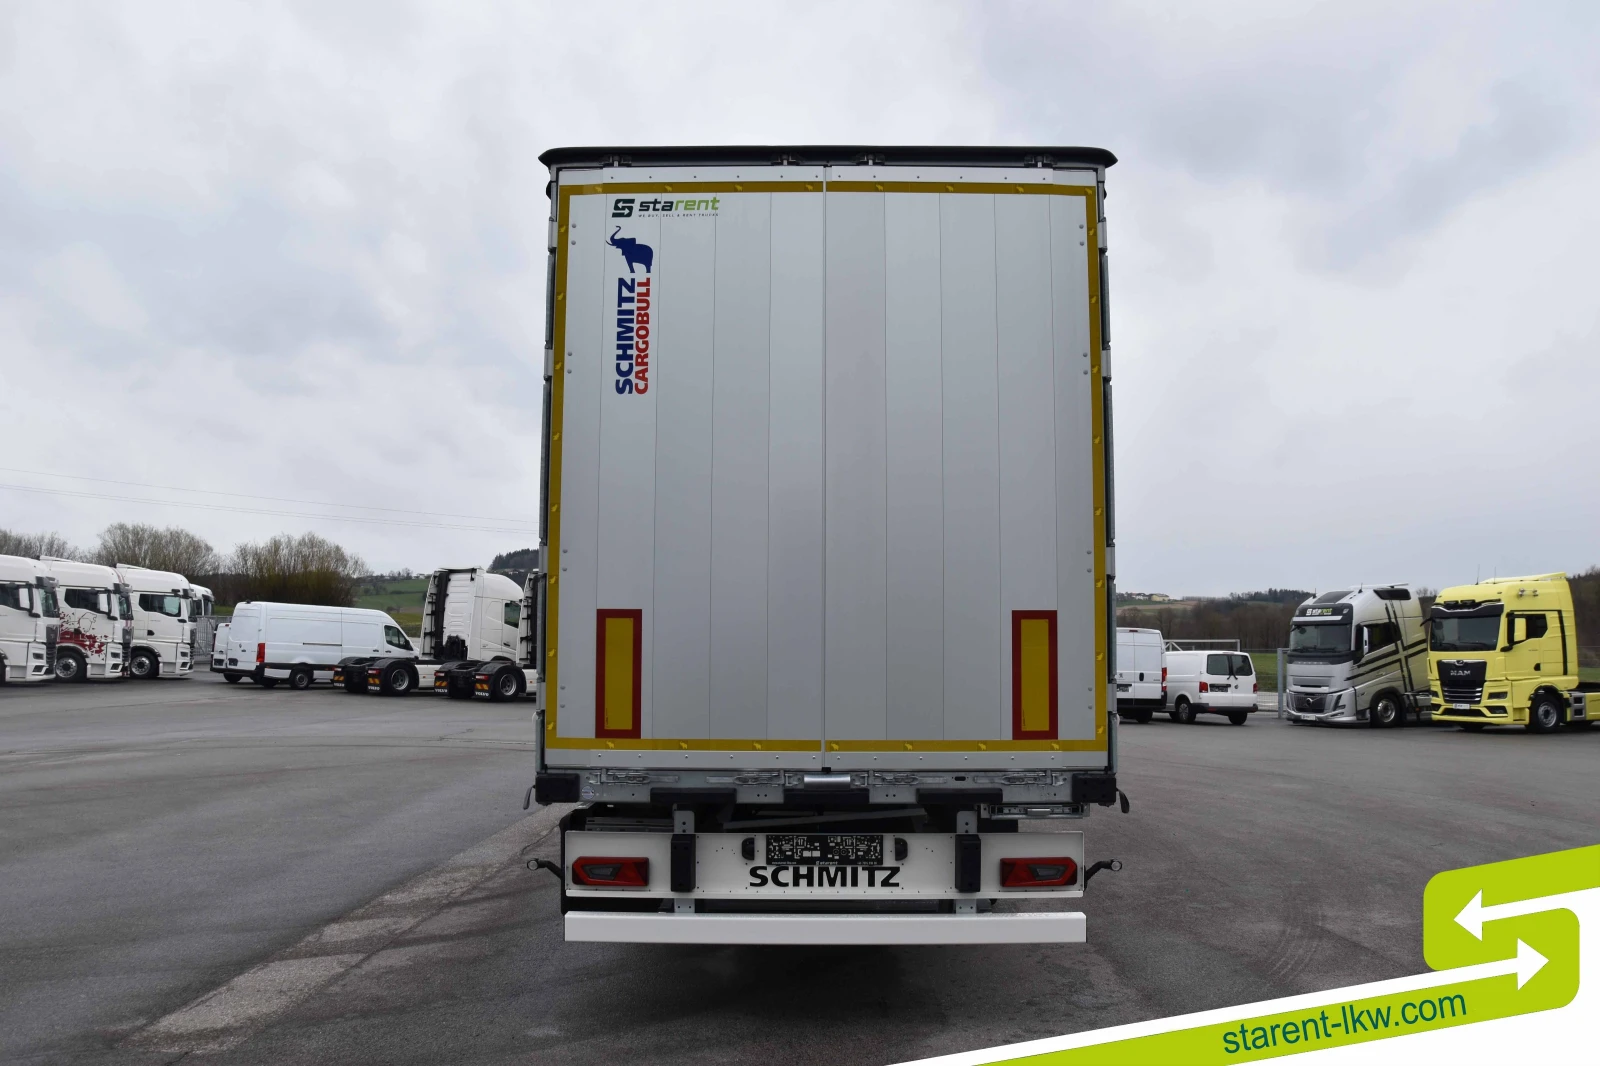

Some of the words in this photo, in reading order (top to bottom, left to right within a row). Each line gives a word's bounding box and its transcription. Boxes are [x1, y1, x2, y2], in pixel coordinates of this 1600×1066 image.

[638, 197, 720, 212] starent
[615, 277, 635, 395] SCHMITZ
[634, 277, 651, 395] CARGOBULL
[749, 866, 901, 888] SCHMITZ
